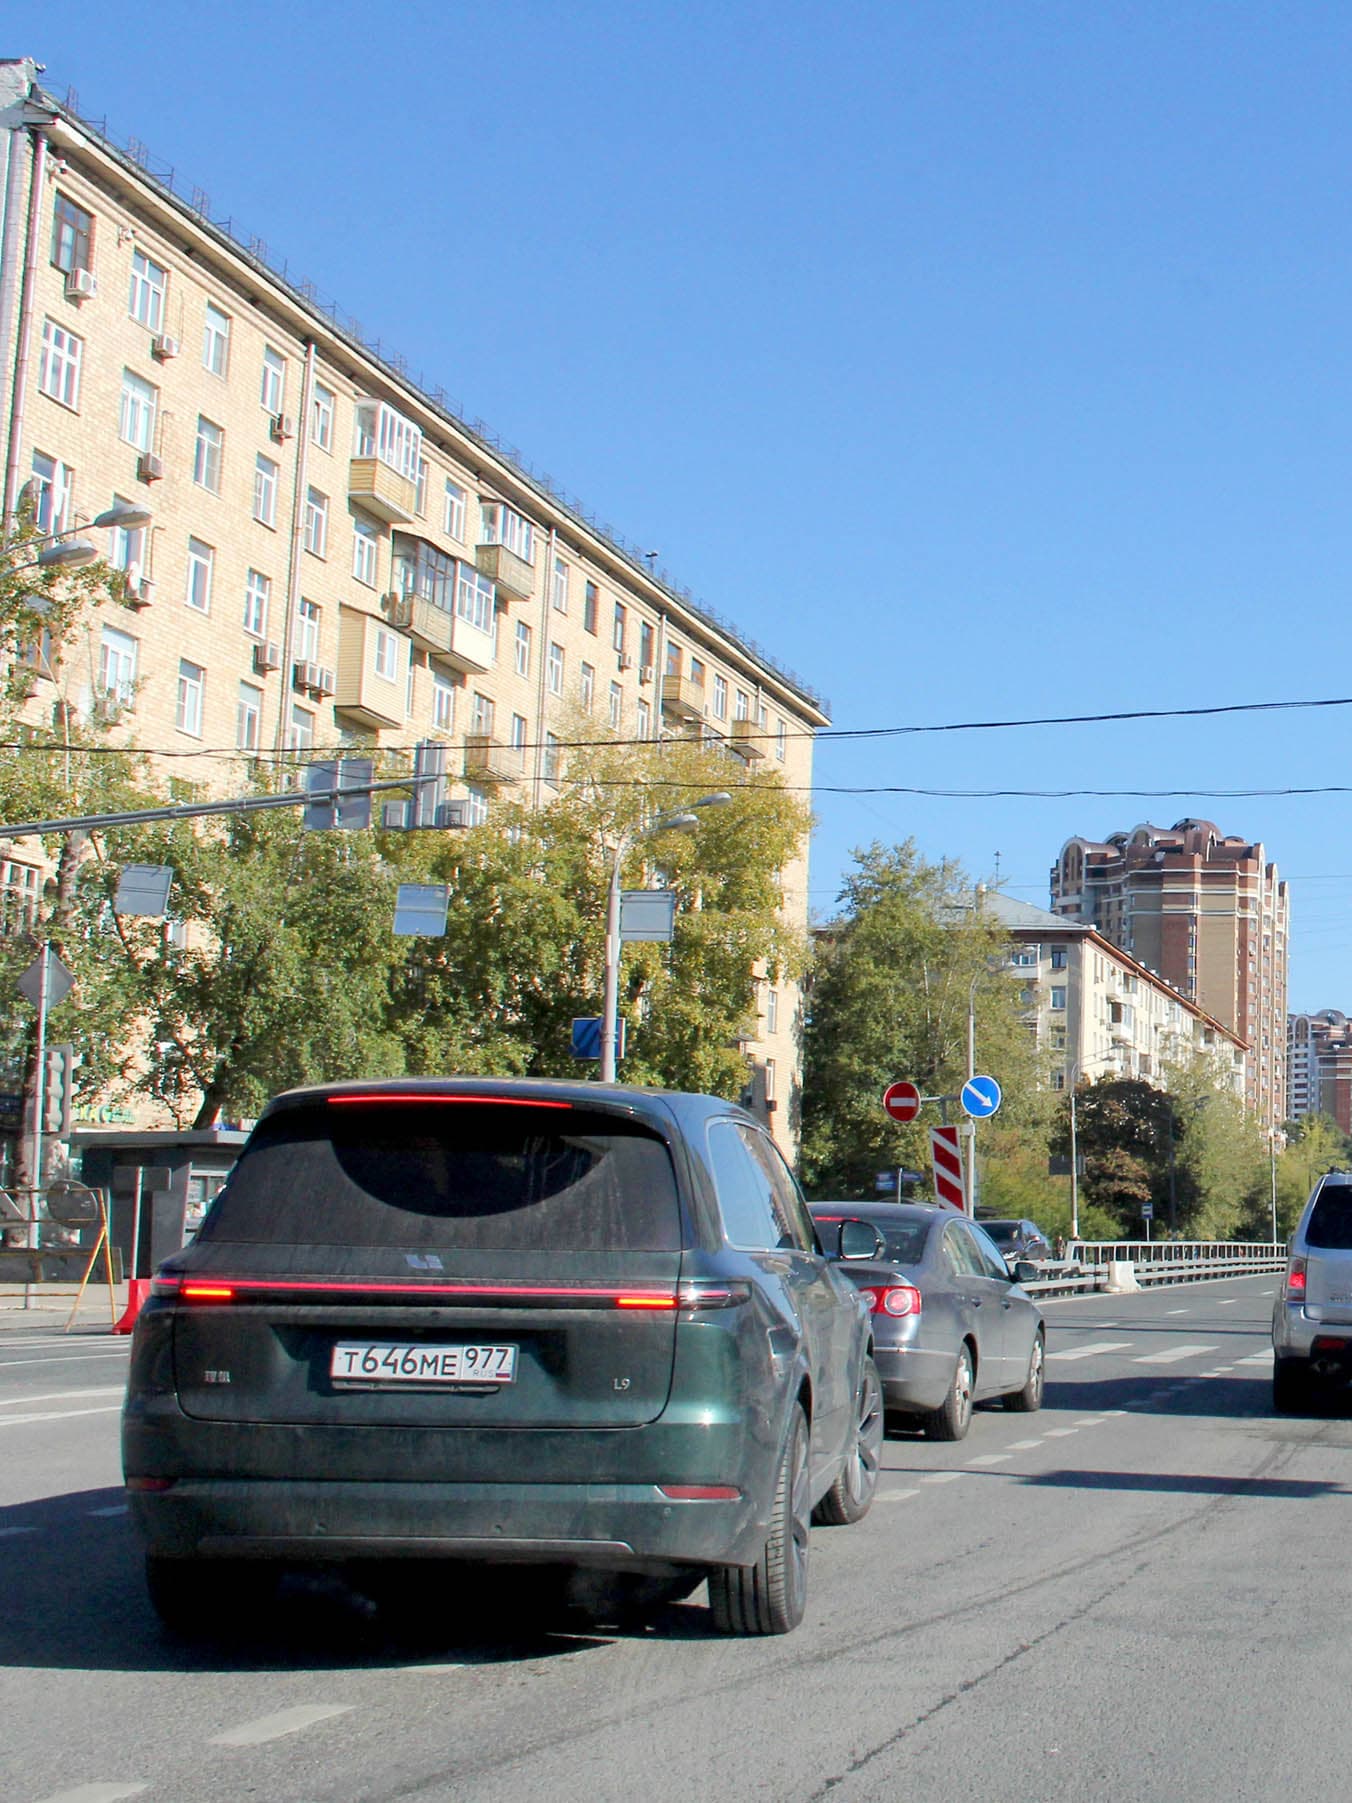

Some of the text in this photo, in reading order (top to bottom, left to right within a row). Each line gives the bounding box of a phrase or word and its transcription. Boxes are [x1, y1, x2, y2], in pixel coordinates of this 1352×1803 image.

[465, 1347, 510, 1369] 977
[472, 1369, 494, 1377] RUS
[613, 1377, 631, 1390] L9
